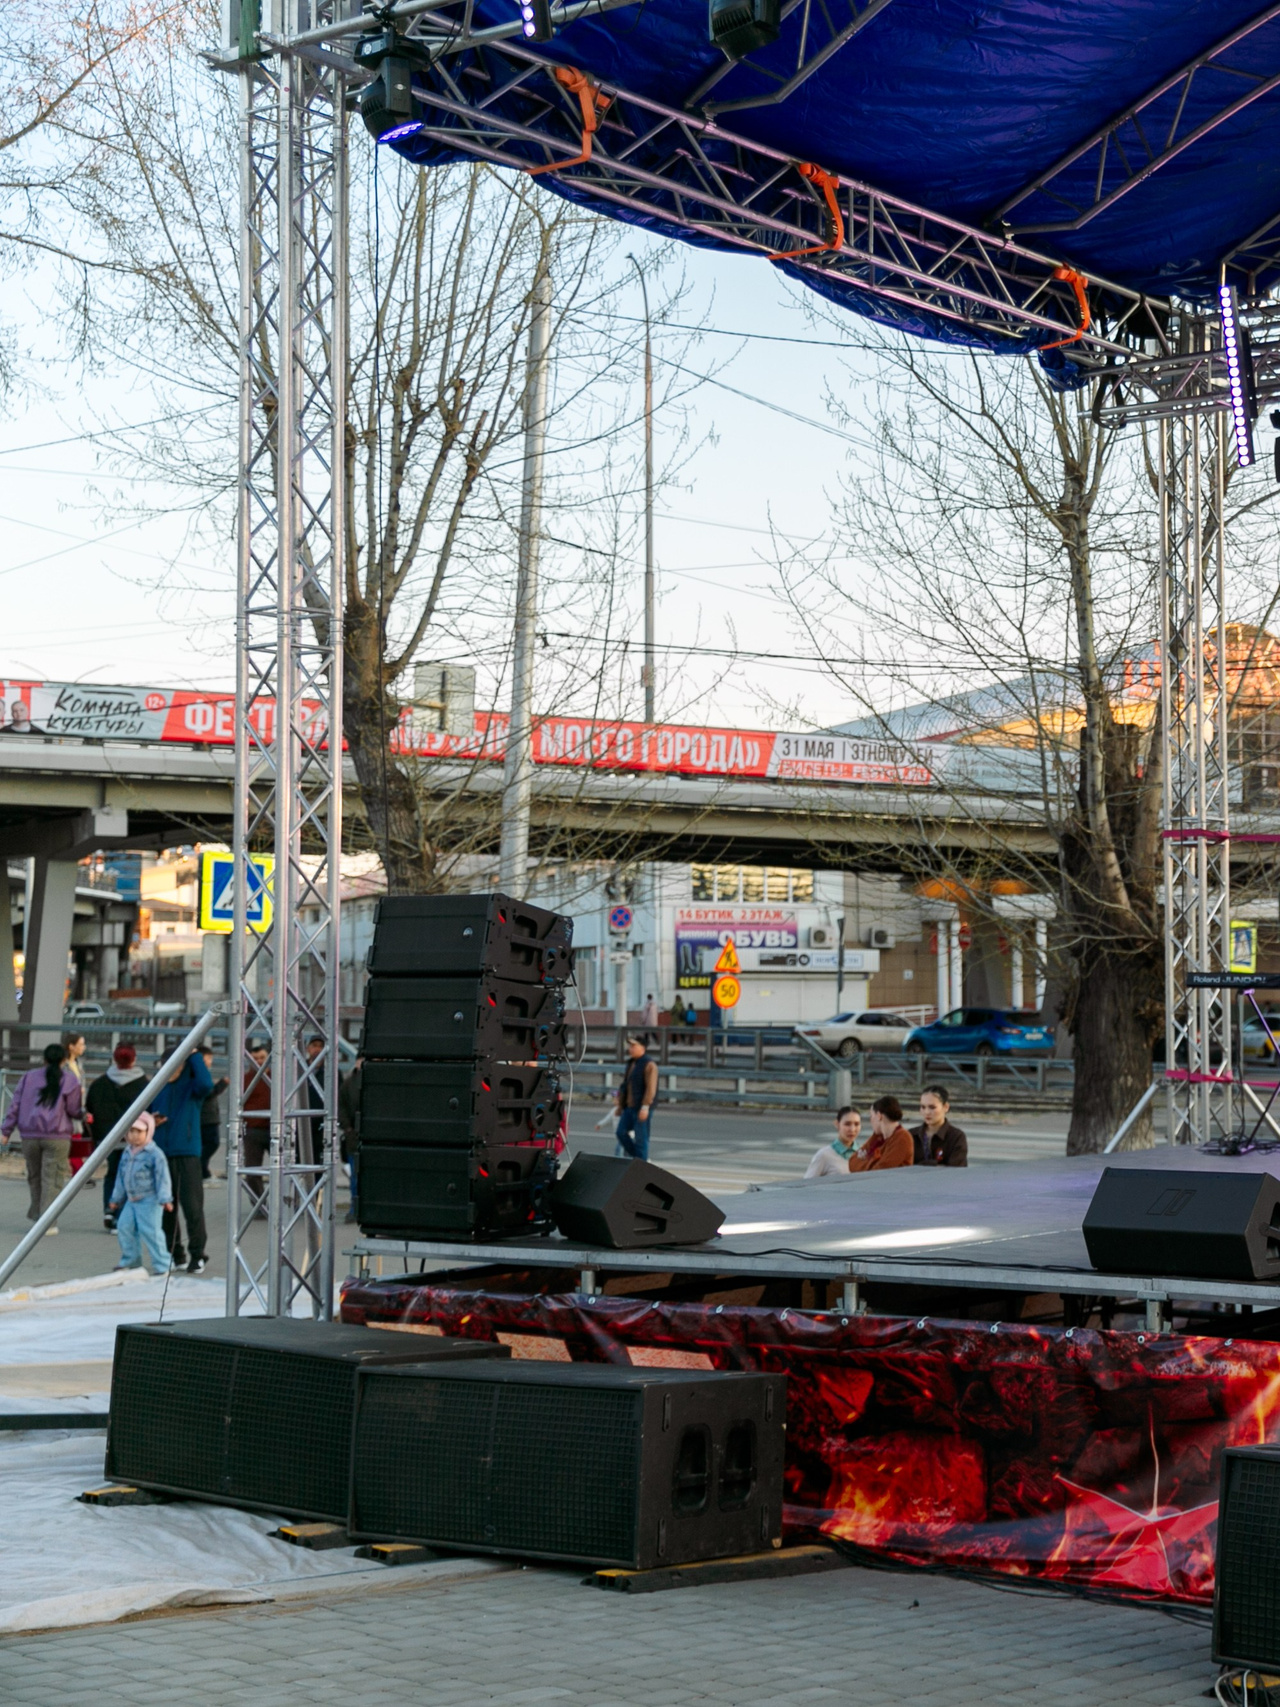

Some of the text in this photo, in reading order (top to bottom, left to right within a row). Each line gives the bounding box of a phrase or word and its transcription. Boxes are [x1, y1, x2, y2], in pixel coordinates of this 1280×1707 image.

[147, 696, 165, 709] 12+
[540, 723, 635, 762] МОЕГО
[641, 731, 761, 773] ГОРОДА»
[782, 739, 799, 756] 31
[804, 740, 834, 759] МАЯ
[679, 909, 783, 920] 14 БУТИК 2 ЭТАЖ
[718, 929, 797, 947] ОБУВЬ
[1193, 975, 1221, 984] Roland
[720, 985, 736, 998] 50
